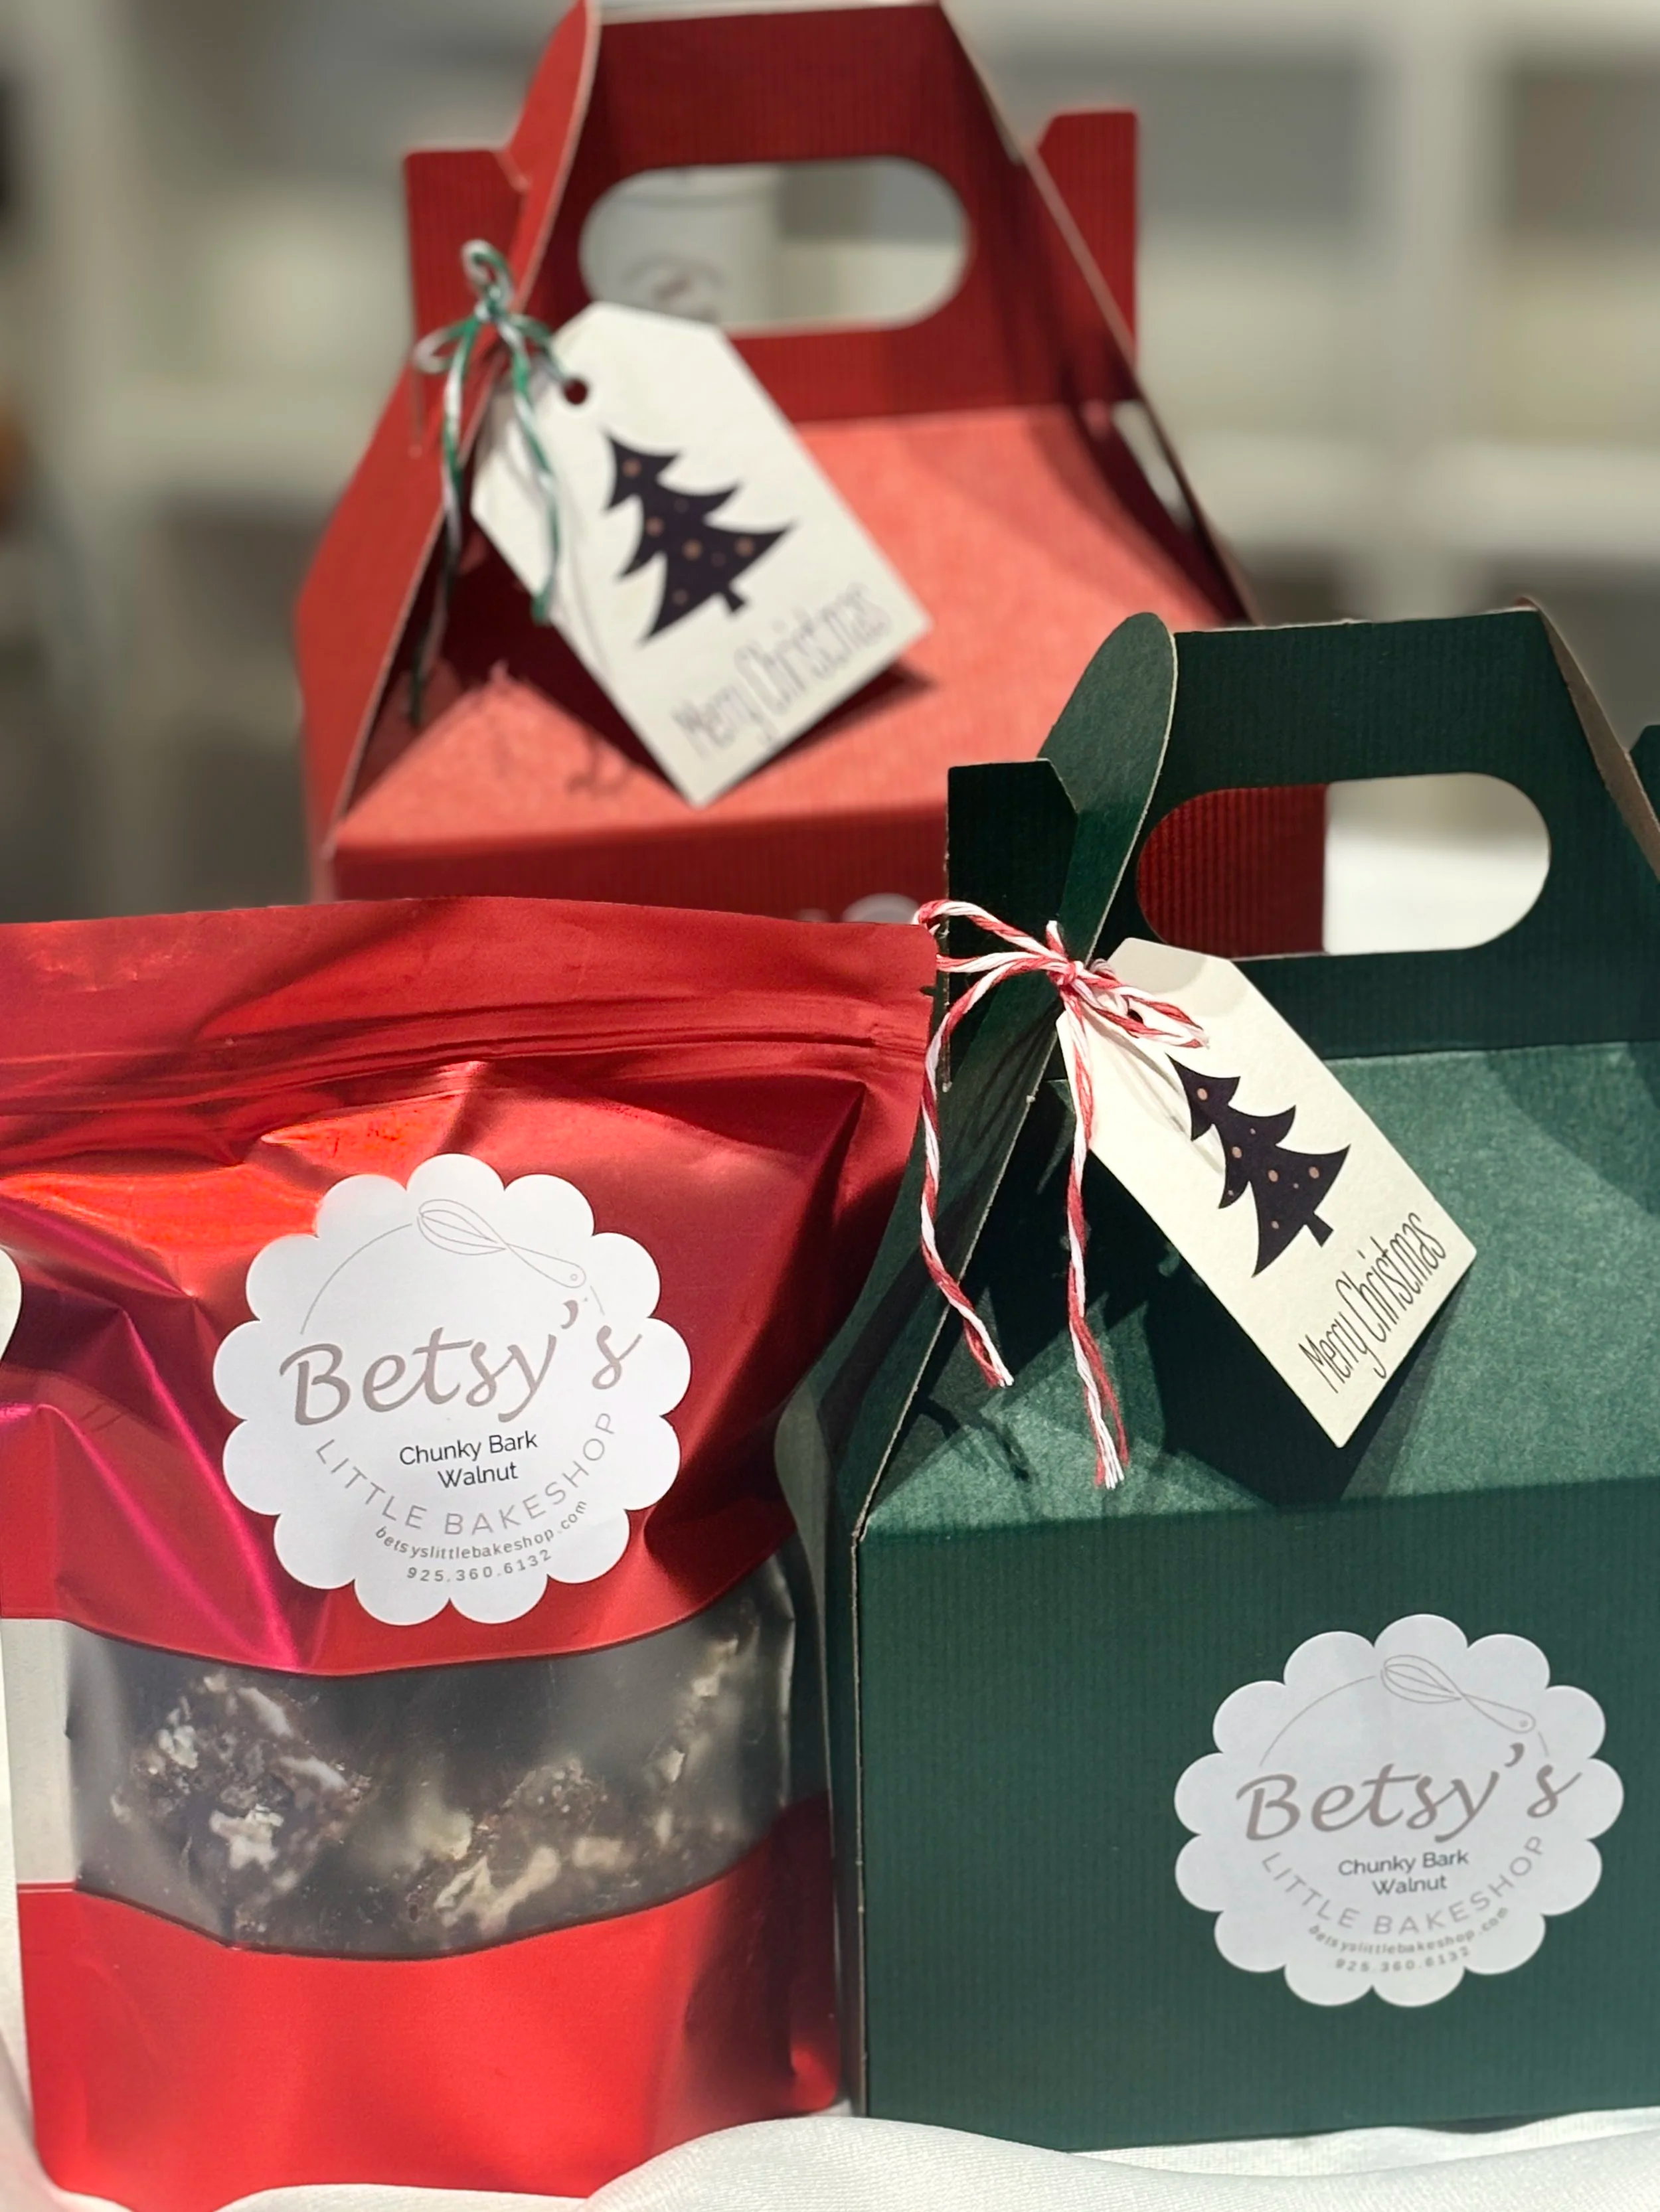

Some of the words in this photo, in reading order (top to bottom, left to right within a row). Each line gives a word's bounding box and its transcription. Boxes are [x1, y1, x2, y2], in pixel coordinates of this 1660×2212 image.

[670, 684, 780, 759] Merry
[733, 582, 892, 716] Christmas
[1335, 1212, 1446, 1343] Christmas
[279, 1299, 643, 1426] Betsy's
[1297, 1311, 1388, 1394] Merry
[315, 1438, 428, 1530] LITTLE
[444, 1412, 616, 1536] BAKESHOP
[398, 1438, 482, 1466] Chunky
[489, 1431, 539, 1455] Bark
[437, 1461, 519, 1489] Walnut
[375, 1499, 588, 1559] betsyslittlebakeshop.com
[406, 1549, 552, 1583] 925.360.6132
[1236, 1742, 1583, 1844] Betsy's
[1262, 1852, 1361, 1927] LITTLE
[1372, 1835, 1545, 1936] BAKESHOP
[1337, 1855, 1417, 1876] Chunky
[1422, 1849, 1470, 1870] Bark
[1372, 1873, 1448, 1897] Walnut
